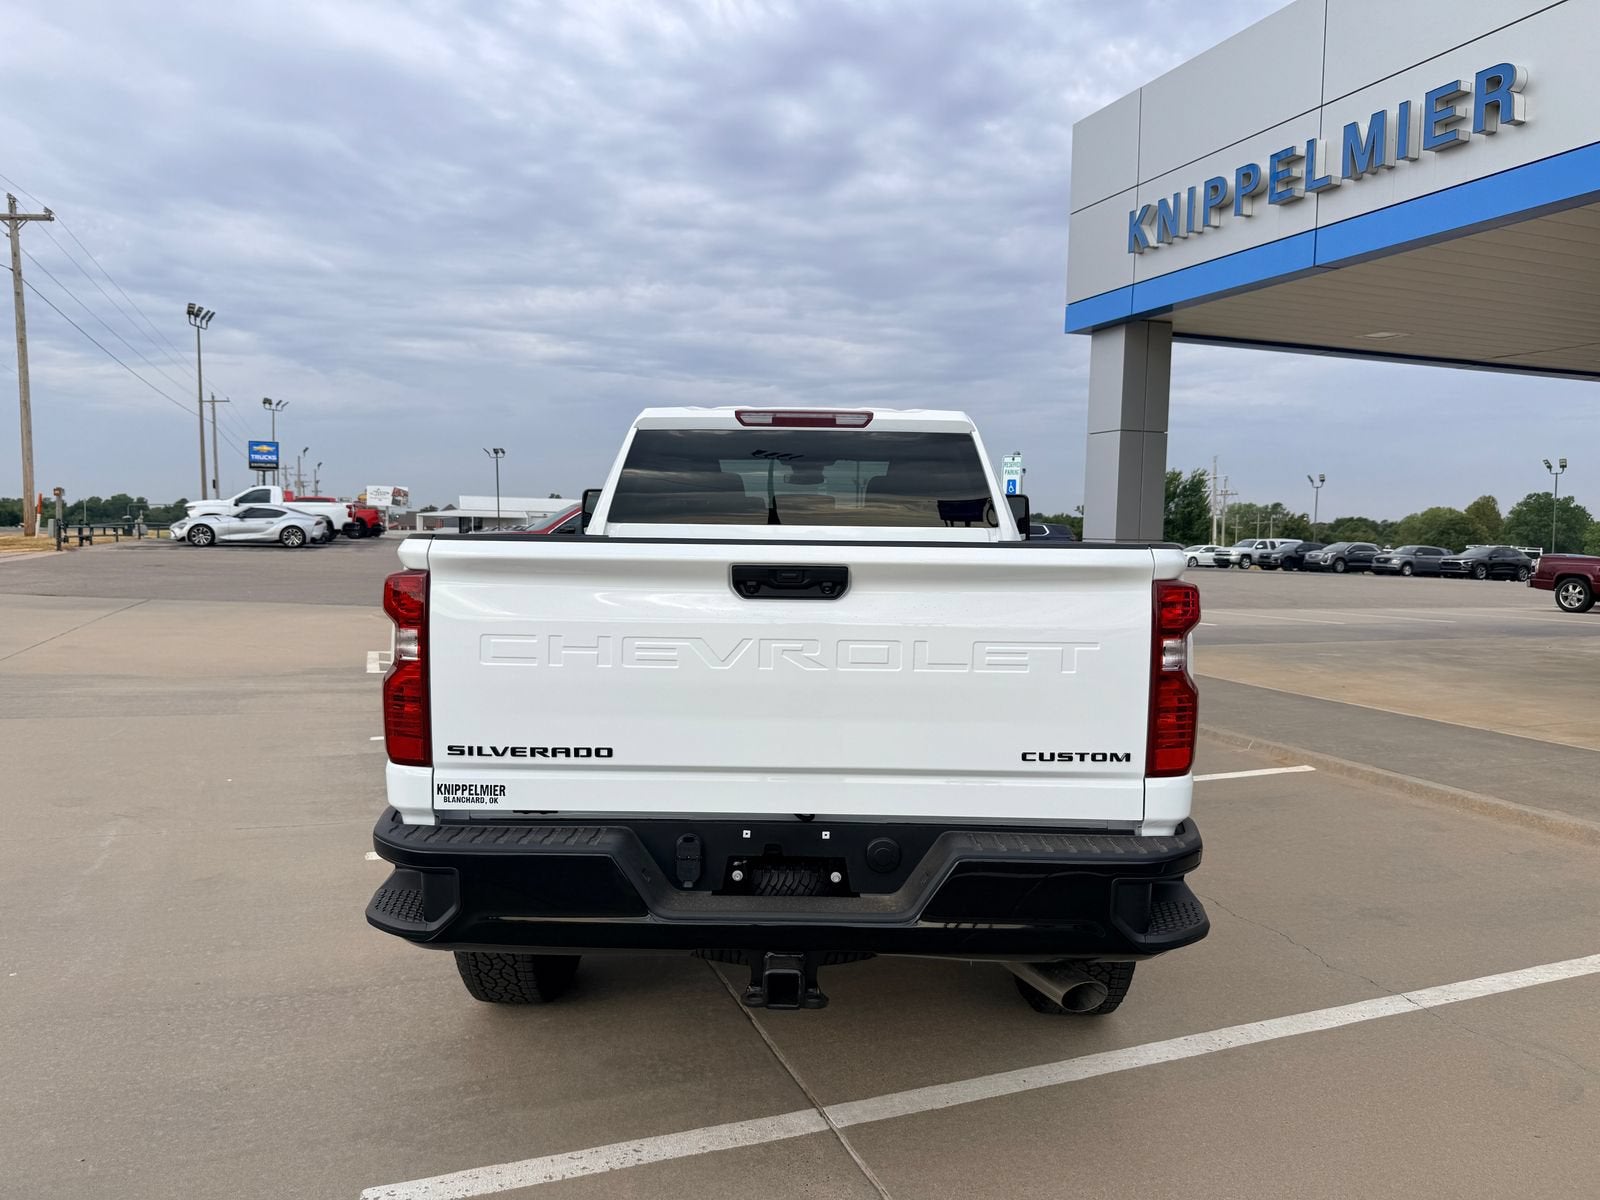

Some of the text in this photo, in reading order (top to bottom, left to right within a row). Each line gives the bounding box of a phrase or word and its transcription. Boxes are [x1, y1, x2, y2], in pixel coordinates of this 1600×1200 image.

[1128, 62, 1527, 254] KNIPPELMIER
[479, 633, 1101, 674] CHEVROLET
[447, 744, 614, 758] SILVERADO
[1021, 752, 1131, 762] CUSTOM
[436, 783, 506, 797] KNIPPELMIER
[443, 796, 487, 805] BLANCHARD,
